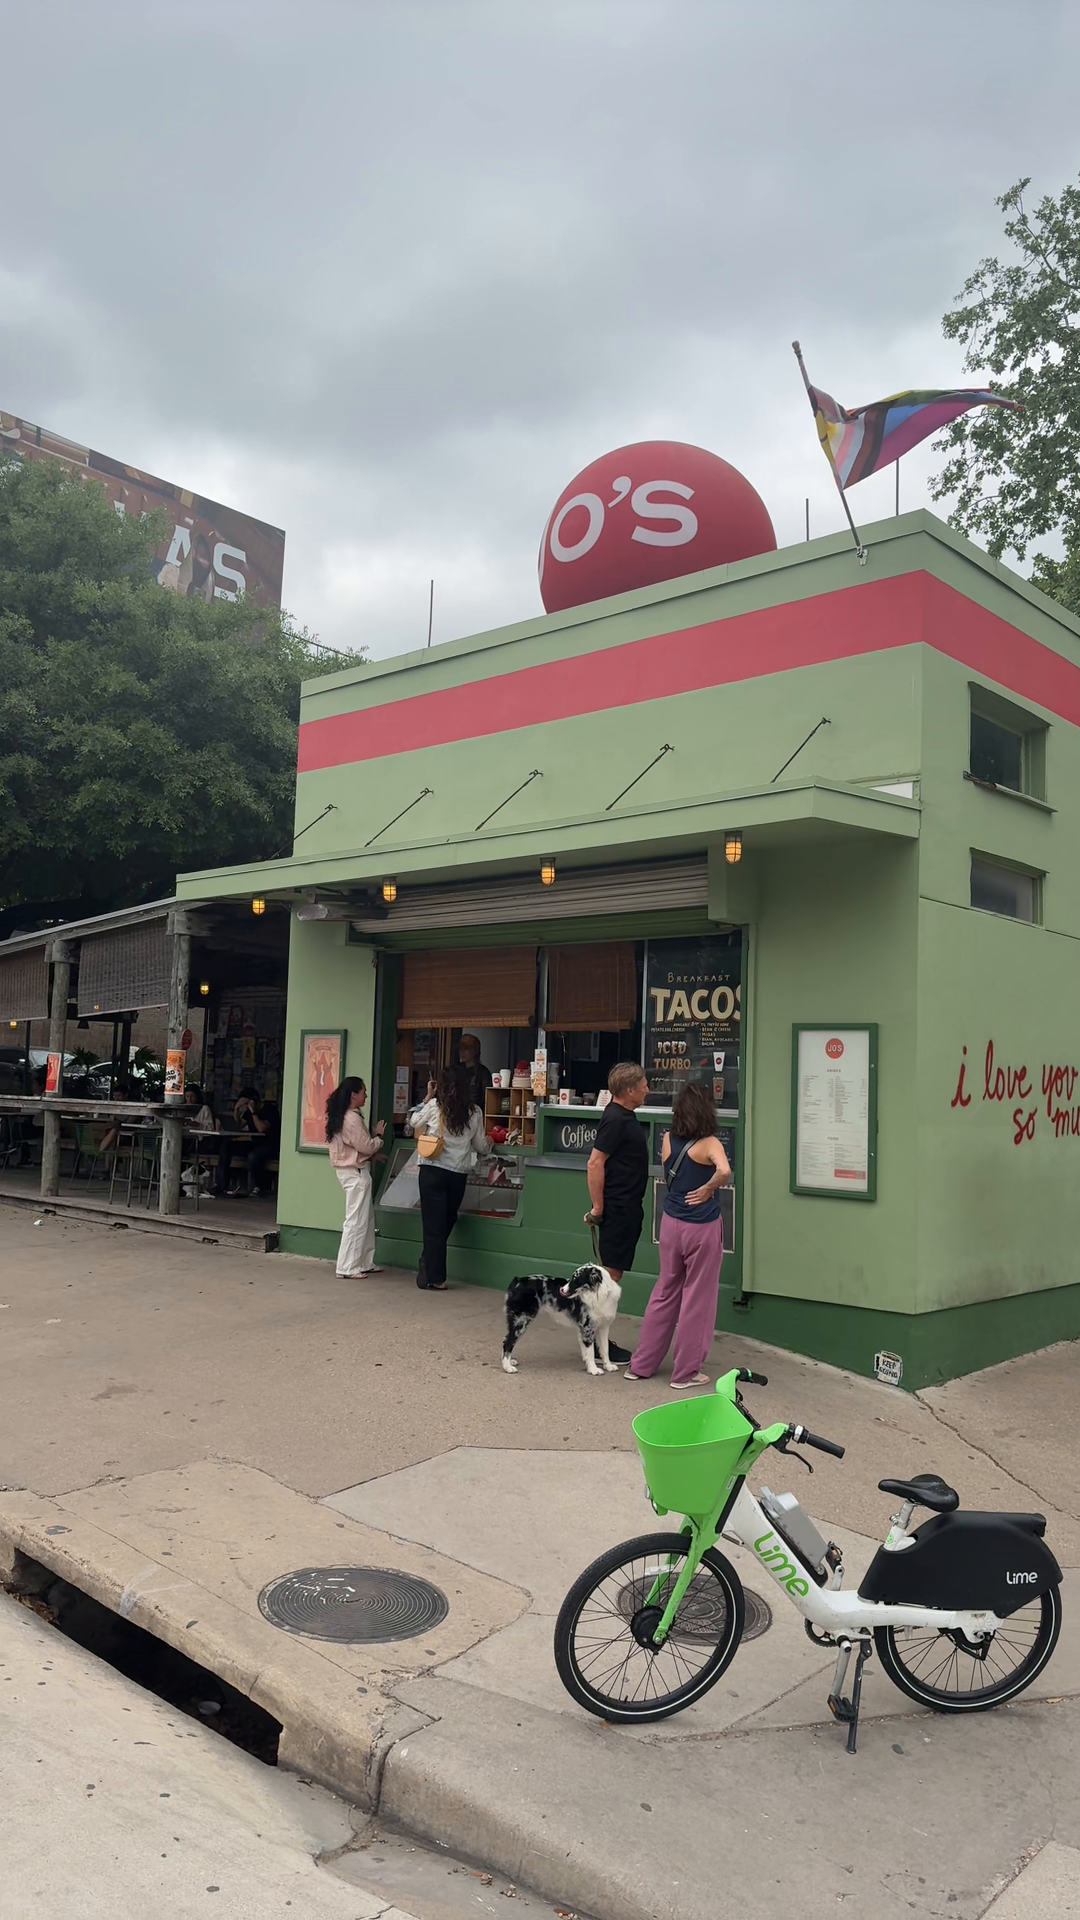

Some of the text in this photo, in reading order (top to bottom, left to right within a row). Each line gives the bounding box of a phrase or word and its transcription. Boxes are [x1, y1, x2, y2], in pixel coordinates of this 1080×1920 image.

[538, 475, 699, 583] O'S
[667, 972, 731, 983] BREAKFAST
[657, 1041, 687, 1055] ICED
[653, 1058, 691, 1070] TURBO
[951, 1045, 971, 1108] i
[982, 1039, 1032, 1101] love
[1012, 1106, 1038, 1145] so
[561, 1124, 598, 1149] Coffee
[882, 1359, 896, 1370] KEEP
[754, 1530, 810, 1597] Lime
[1006, 1571, 1038, 1585] Lime
